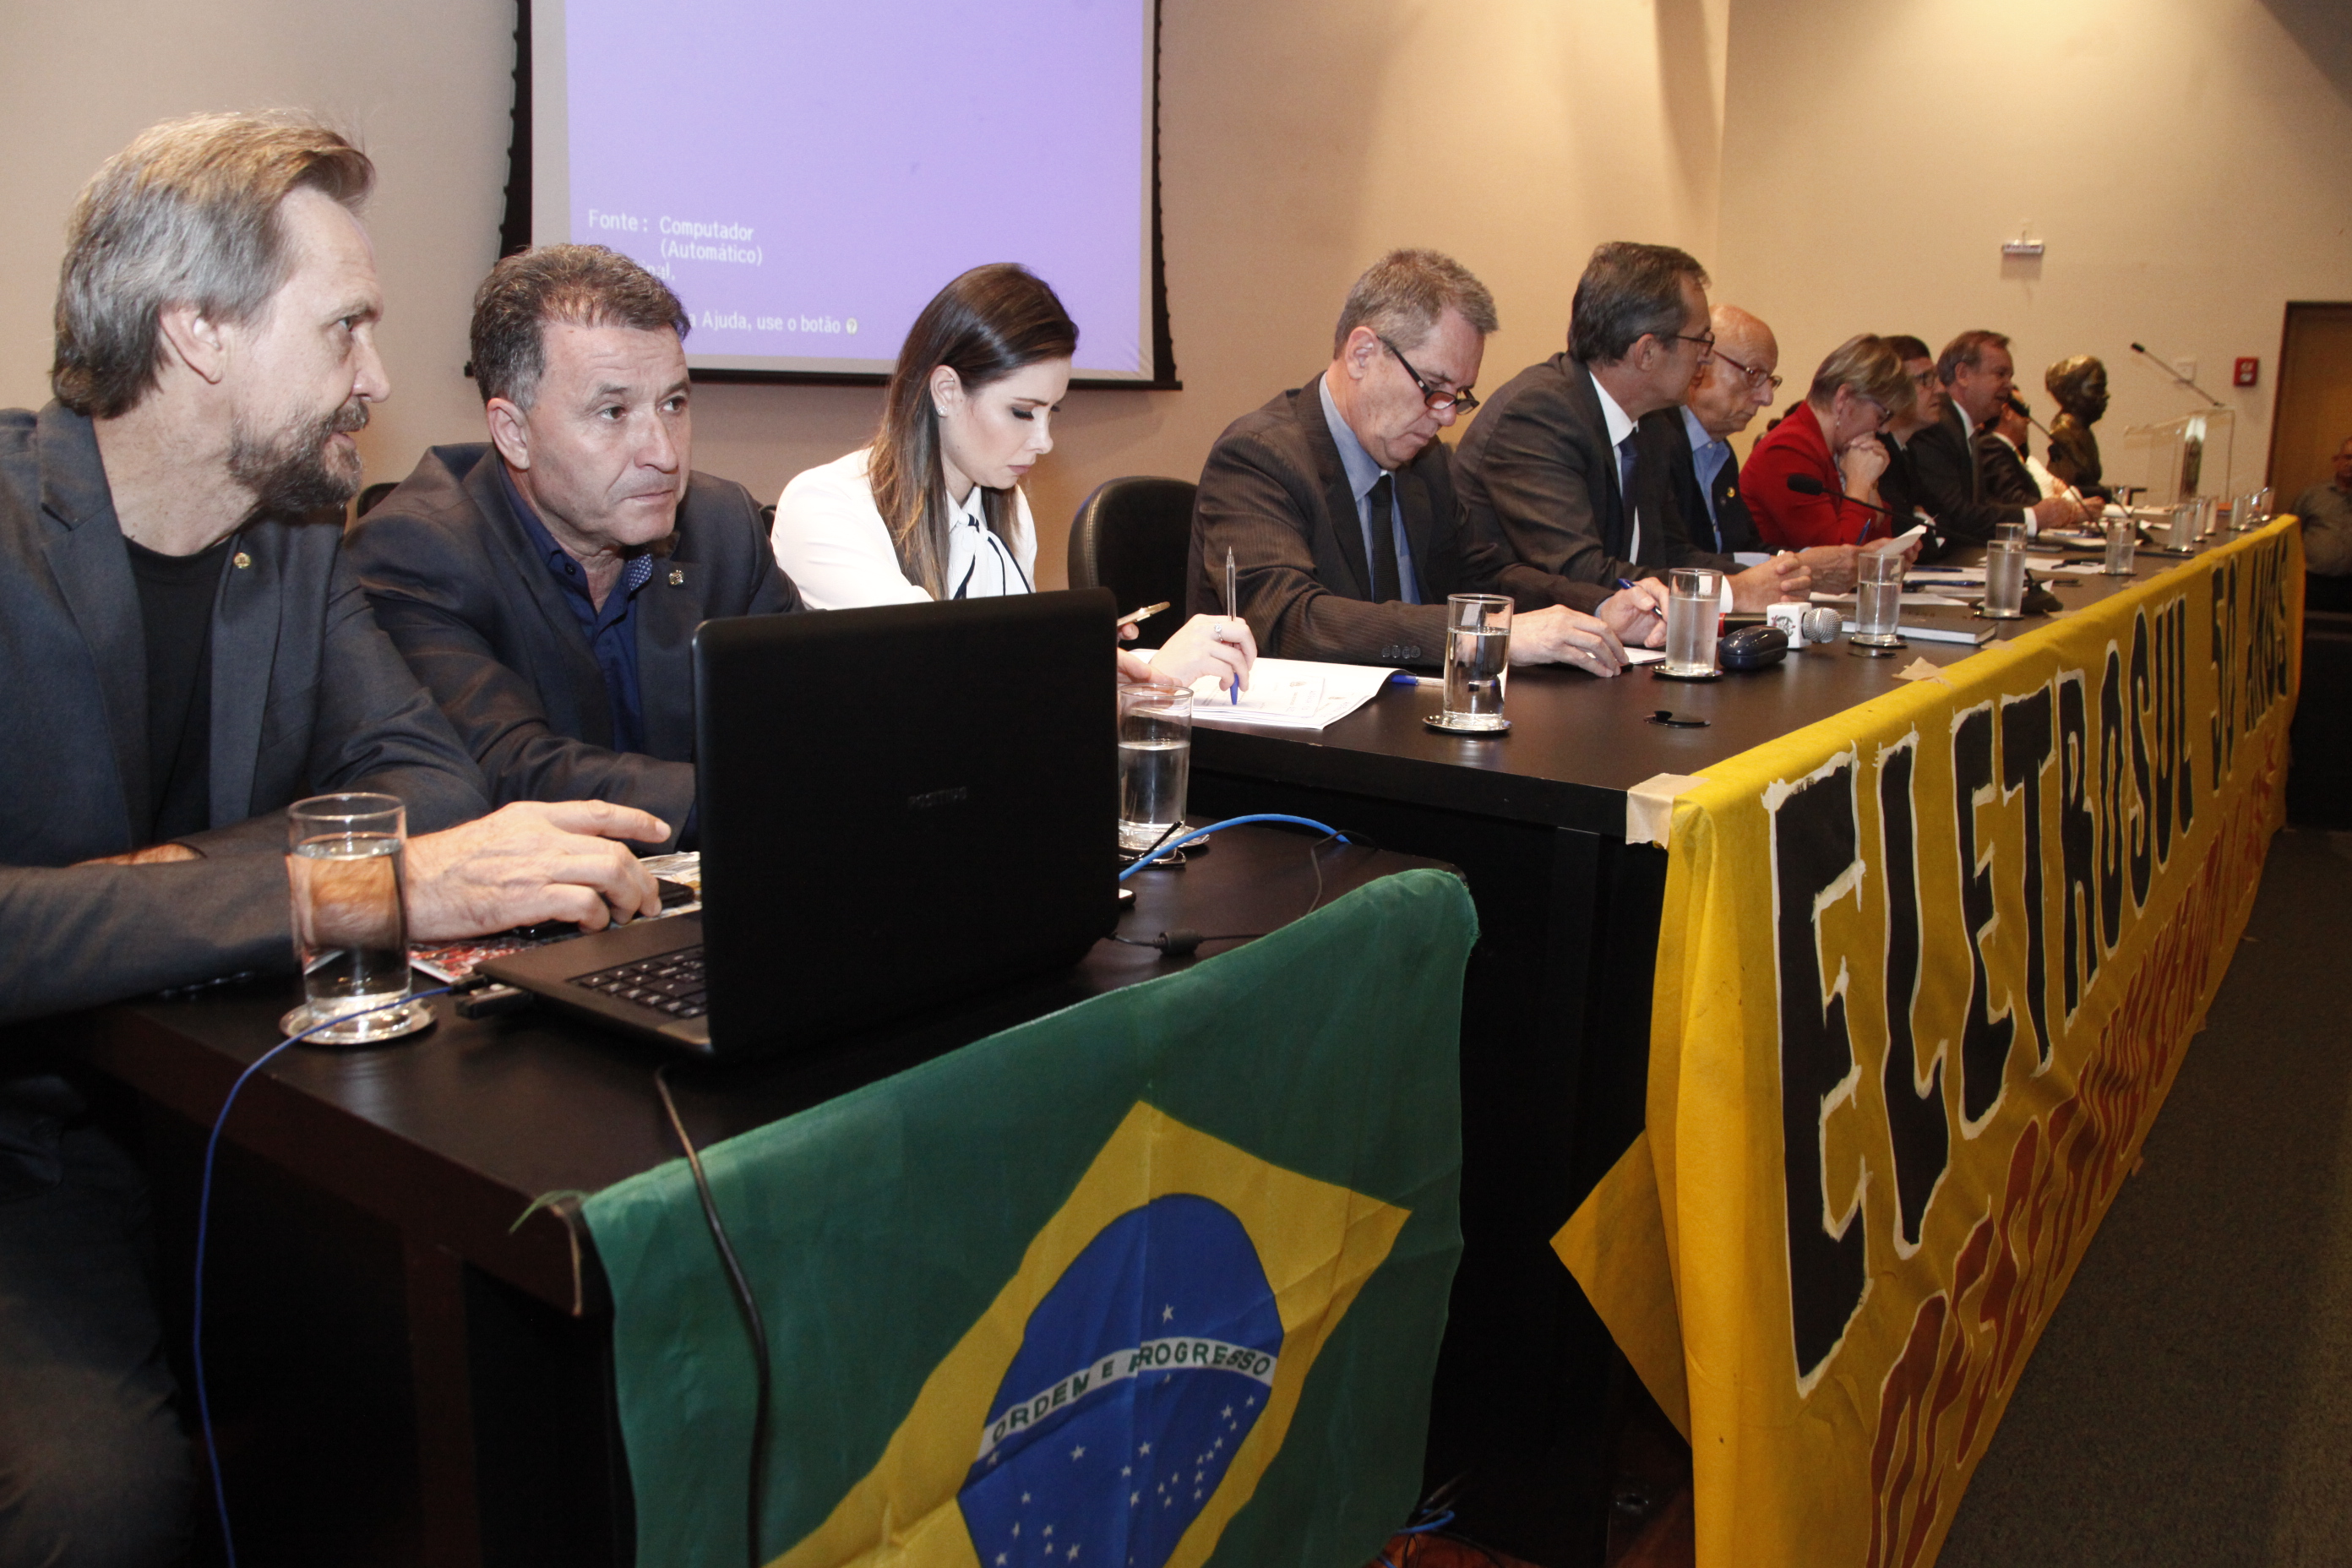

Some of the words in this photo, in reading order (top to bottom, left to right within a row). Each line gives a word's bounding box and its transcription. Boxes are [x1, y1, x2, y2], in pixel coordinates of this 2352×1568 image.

[659, 215, 754, 242] Computador
[661, 238, 763, 265] (Automático)
[702, 310, 752, 331] Ajuda,
[757, 315, 783, 331] use
[787, 318, 797, 331] o
[801, 314, 841, 334] botão
[1761, 591, 2194, 1399] ELETROSUL
[991, 1371, 1090, 1445] ORDEM
[1102, 1359, 1114, 1379] E
[1128, 1342, 1271, 1376] PROGRESSO
